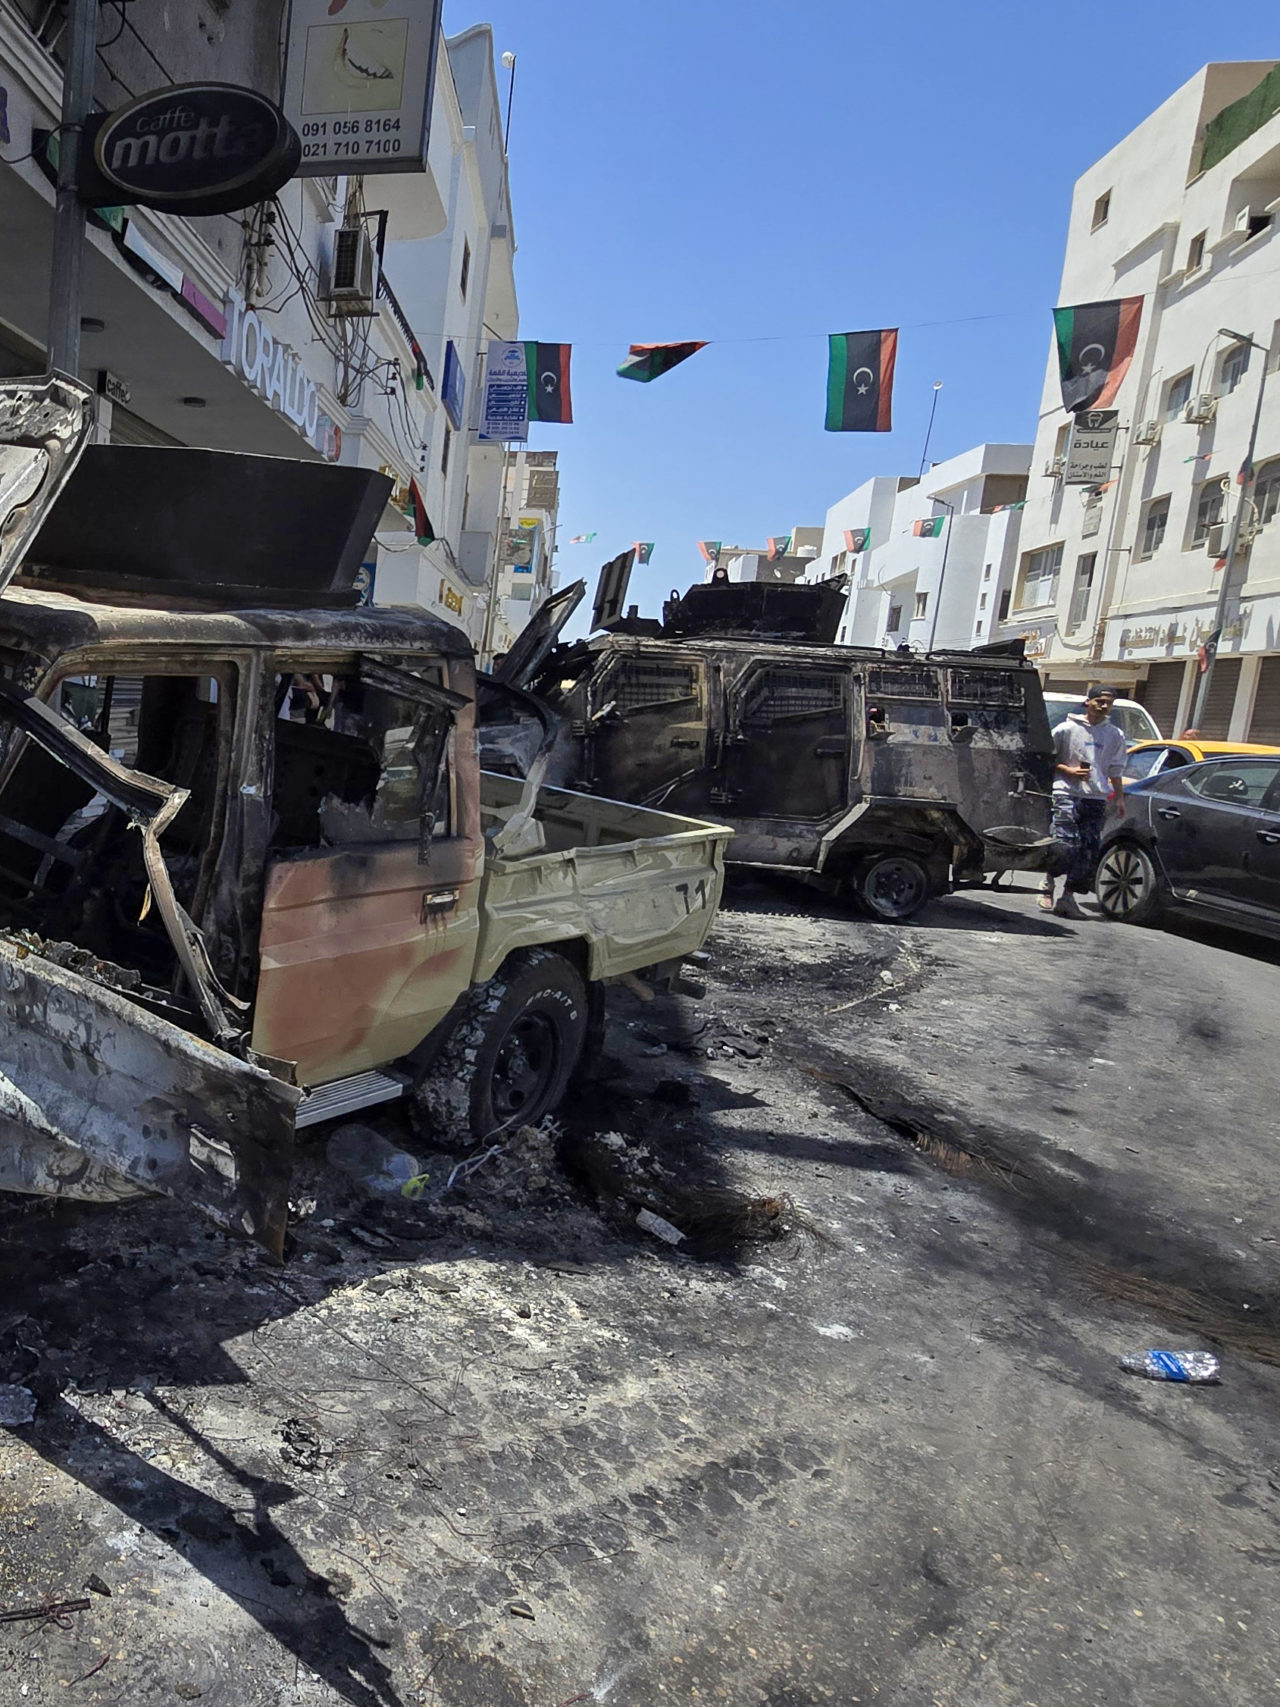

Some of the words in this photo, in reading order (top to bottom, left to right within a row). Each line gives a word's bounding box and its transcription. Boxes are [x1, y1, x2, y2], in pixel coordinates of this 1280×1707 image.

[302, 122, 327, 137] 091
[333, 120, 360, 135] 056
[364, 118, 400, 133] 8164
[302, 142, 328, 157] 021
[334, 140, 360, 156] 710
[365, 139, 401, 153] 7100
[228, 286, 318, 437] TORALDO
[1073, 439, 1109, 451] عيادة
[675, 879, 706, 914] 71
